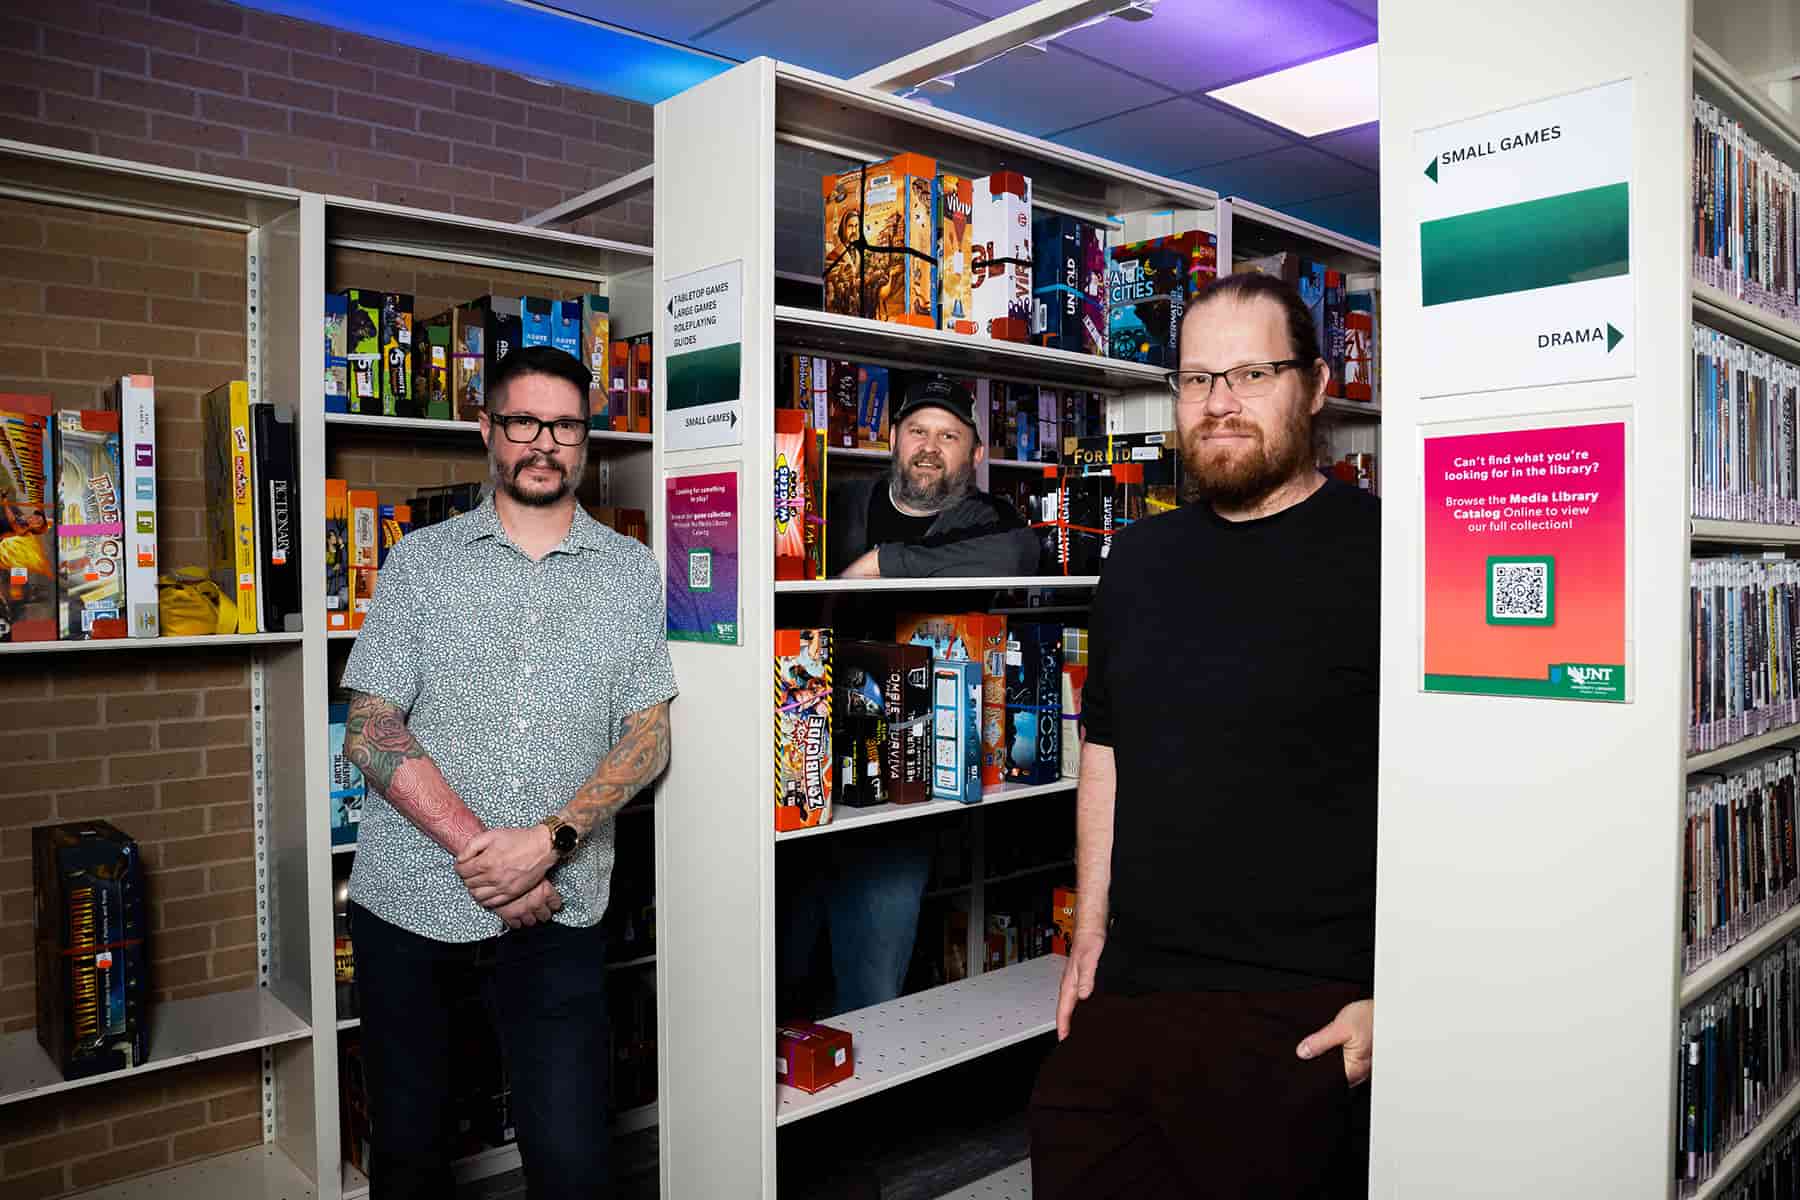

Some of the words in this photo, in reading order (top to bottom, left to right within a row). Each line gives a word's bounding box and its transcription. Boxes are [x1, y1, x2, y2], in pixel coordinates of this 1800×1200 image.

[1442, 141, 1496, 166] SMALL
[1500, 125, 1562, 152] GAMES
[674, 288, 704, 304] TABLETOP
[705, 282, 729, 296] GAMES
[1065, 258, 1076, 315] UNOLD
[1111, 280, 1154, 302] CITIES
[674, 305, 693, 319] LARGE
[694, 300, 717, 314] GAMES
[674, 315, 717, 333] ROLEPLAYING
[674, 335, 697, 348] GUIDES
[1538, 327, 1604, 349] DRAMA
[591, 336, 604, 390] ACUIRE
[685, 417, 706, 428] SMALL
[706, 412, 730, 424] GAMES
[1074, 447, 1163, 465] FORIDN
[1454, 456, 1486, 467] Can't
[1488, 455, 1511, 465] find
[1514, 453, 1544, 463] what
[1547, 450, 1589, 464] you're
[1445, 469, 1488, 481] looking
[1491, 468, 1509, 479] for
[1512, 467, 1523, 477] in
[1526, 465, 1546, 476] the
[1550, 462, 1600, 476] library?
[779, 467, 789, 521] WAGERS
[1446, 496, 1485, 507] Browse
[1488, 495, 1507, 505] the
[1510, 492, 1548, 504] Media
[1552, 491, 1599, 504] Library
[275, 480, 290, 553] PICTIONARY
[1104, 495, 1113, 546] AERGATE
[1454, 508, 1500, 520] Catalog
[1504, 507, 1543, 518] Online
[1545, 506, 1558, 516] to
[1561, 505, 1590, 516] view
[88, 472, 122, 577] FRECO
[1058, 488, 1070, 563] WATEGATE
[1468, 523, 1486, 532] our
[1489, 520, 1507, 531] full
[1510, 519, 1573, 531] collection!
[1579, 667, 1613, 681] UNT
[891, 673, 901, 713] OMBIE
[806, 717, 823, 808] ZOMBICIDE
[890, 731, 900, 780] URVIVA
[334, 753, 342, 784] ARCTIC
